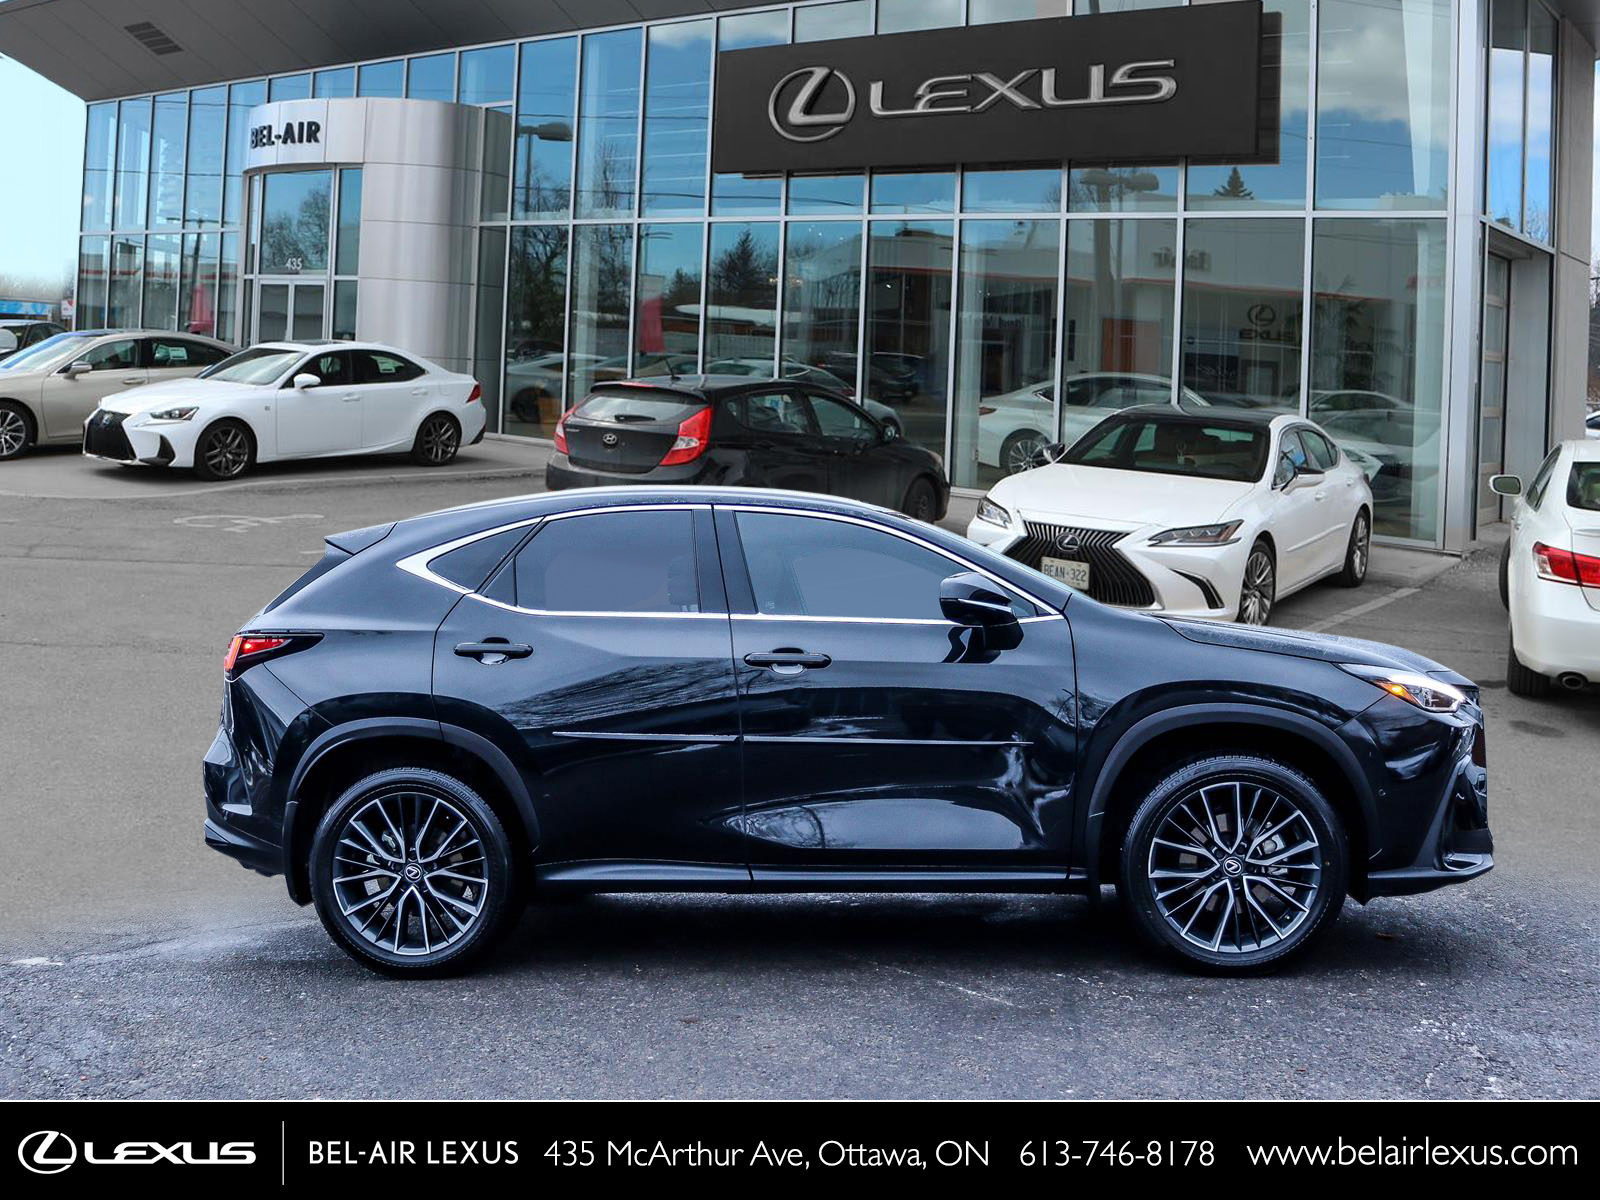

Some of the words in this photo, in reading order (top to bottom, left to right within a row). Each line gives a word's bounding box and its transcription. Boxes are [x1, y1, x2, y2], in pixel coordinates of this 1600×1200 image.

[869, 59, 1177, 117] LEXUS
[250, 120, 321, 149] BEL-AIR
[286, 257, 303, 270] 435
[1043, 563, 1065, 579] BEAN
[1069, 568, 1087, 582] 322
